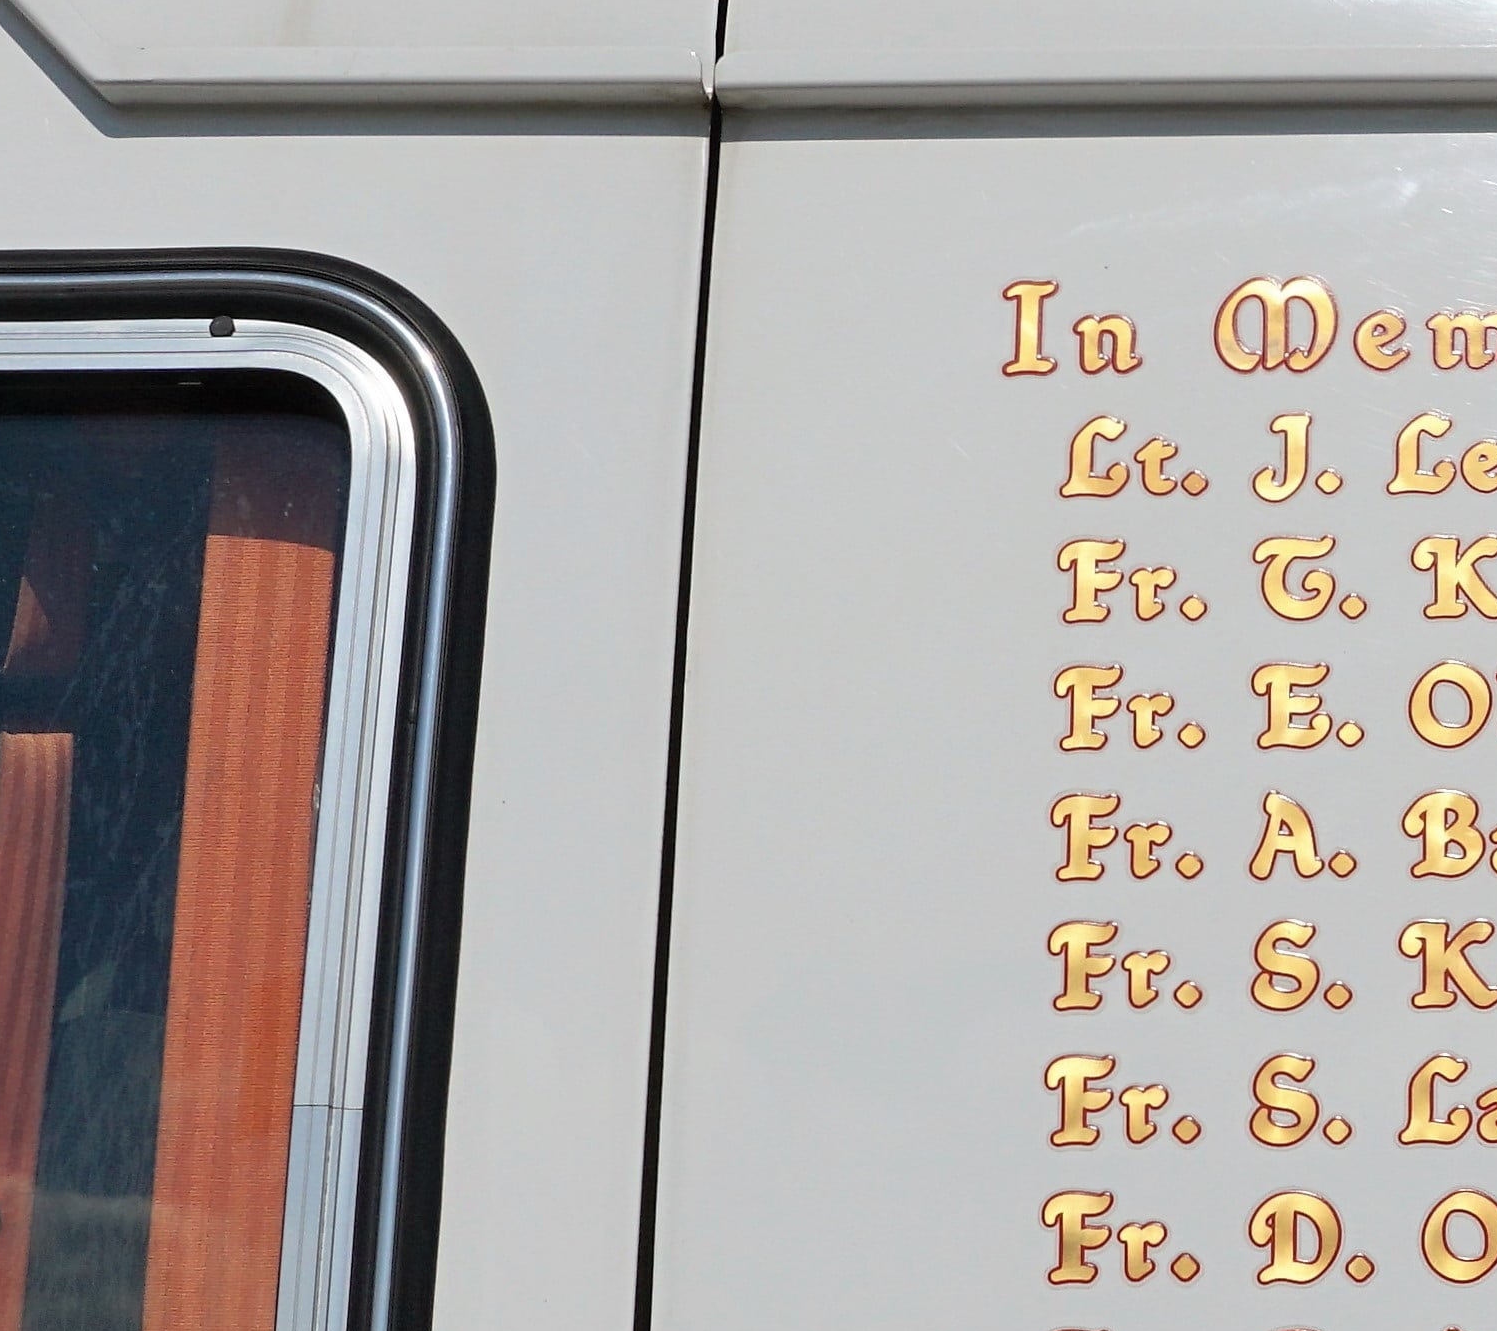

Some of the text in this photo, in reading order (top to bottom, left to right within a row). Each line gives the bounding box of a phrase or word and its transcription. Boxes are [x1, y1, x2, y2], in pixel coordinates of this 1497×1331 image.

[1001, 279, 1144, 378] In
[1058, 414, 1210, 499] Lt.
[1251, 412, 1344, 503] J.
[1056, 537, 1209, 625] Fr.
[1251, 534, 1369, 622] T.
[1053, 664, 1208, 753] Fr.
[1249, 662, 1366, 751] E.
[1049, 792, 1206, 883] Fr.
[1248, 791, 1359, 882] A.
[1046, 919, 1204, 1013] Fr.
[1249, 919, 1354, 1013] S.
[1043, 1053, 1203, 1149] Fr.
[1248, 1053, 1354, 1149] S.
[1040, 1189, 1202, 1287] Fr.
[1247, 1190, 1377, 1286] D.
